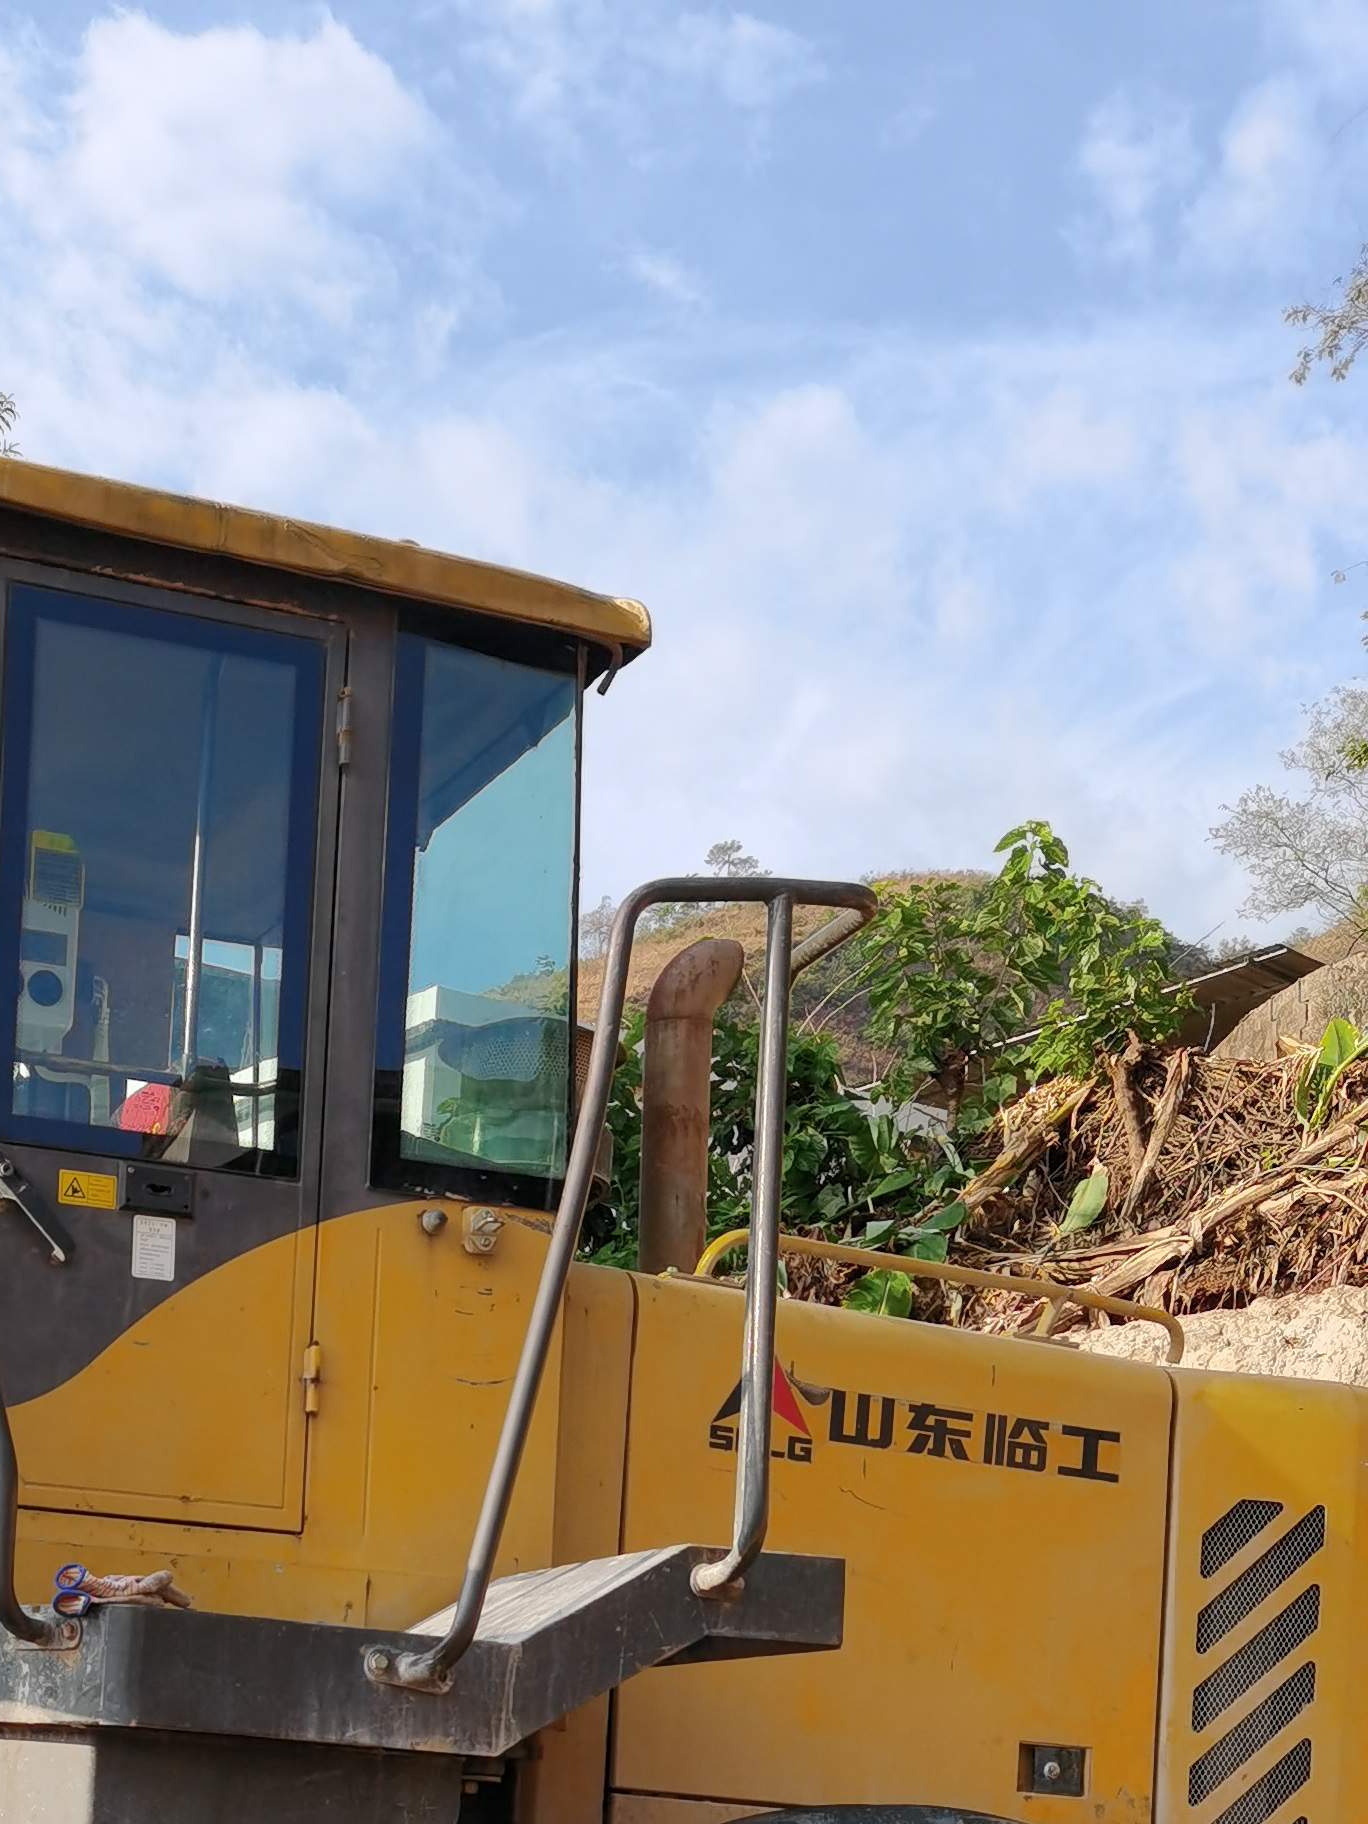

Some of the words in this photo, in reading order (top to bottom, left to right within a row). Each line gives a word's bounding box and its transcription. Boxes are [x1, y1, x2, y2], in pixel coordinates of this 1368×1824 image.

[709, 1424, 813, 1464] SG
[829, 1388, 1121, 1483] 山东临工
